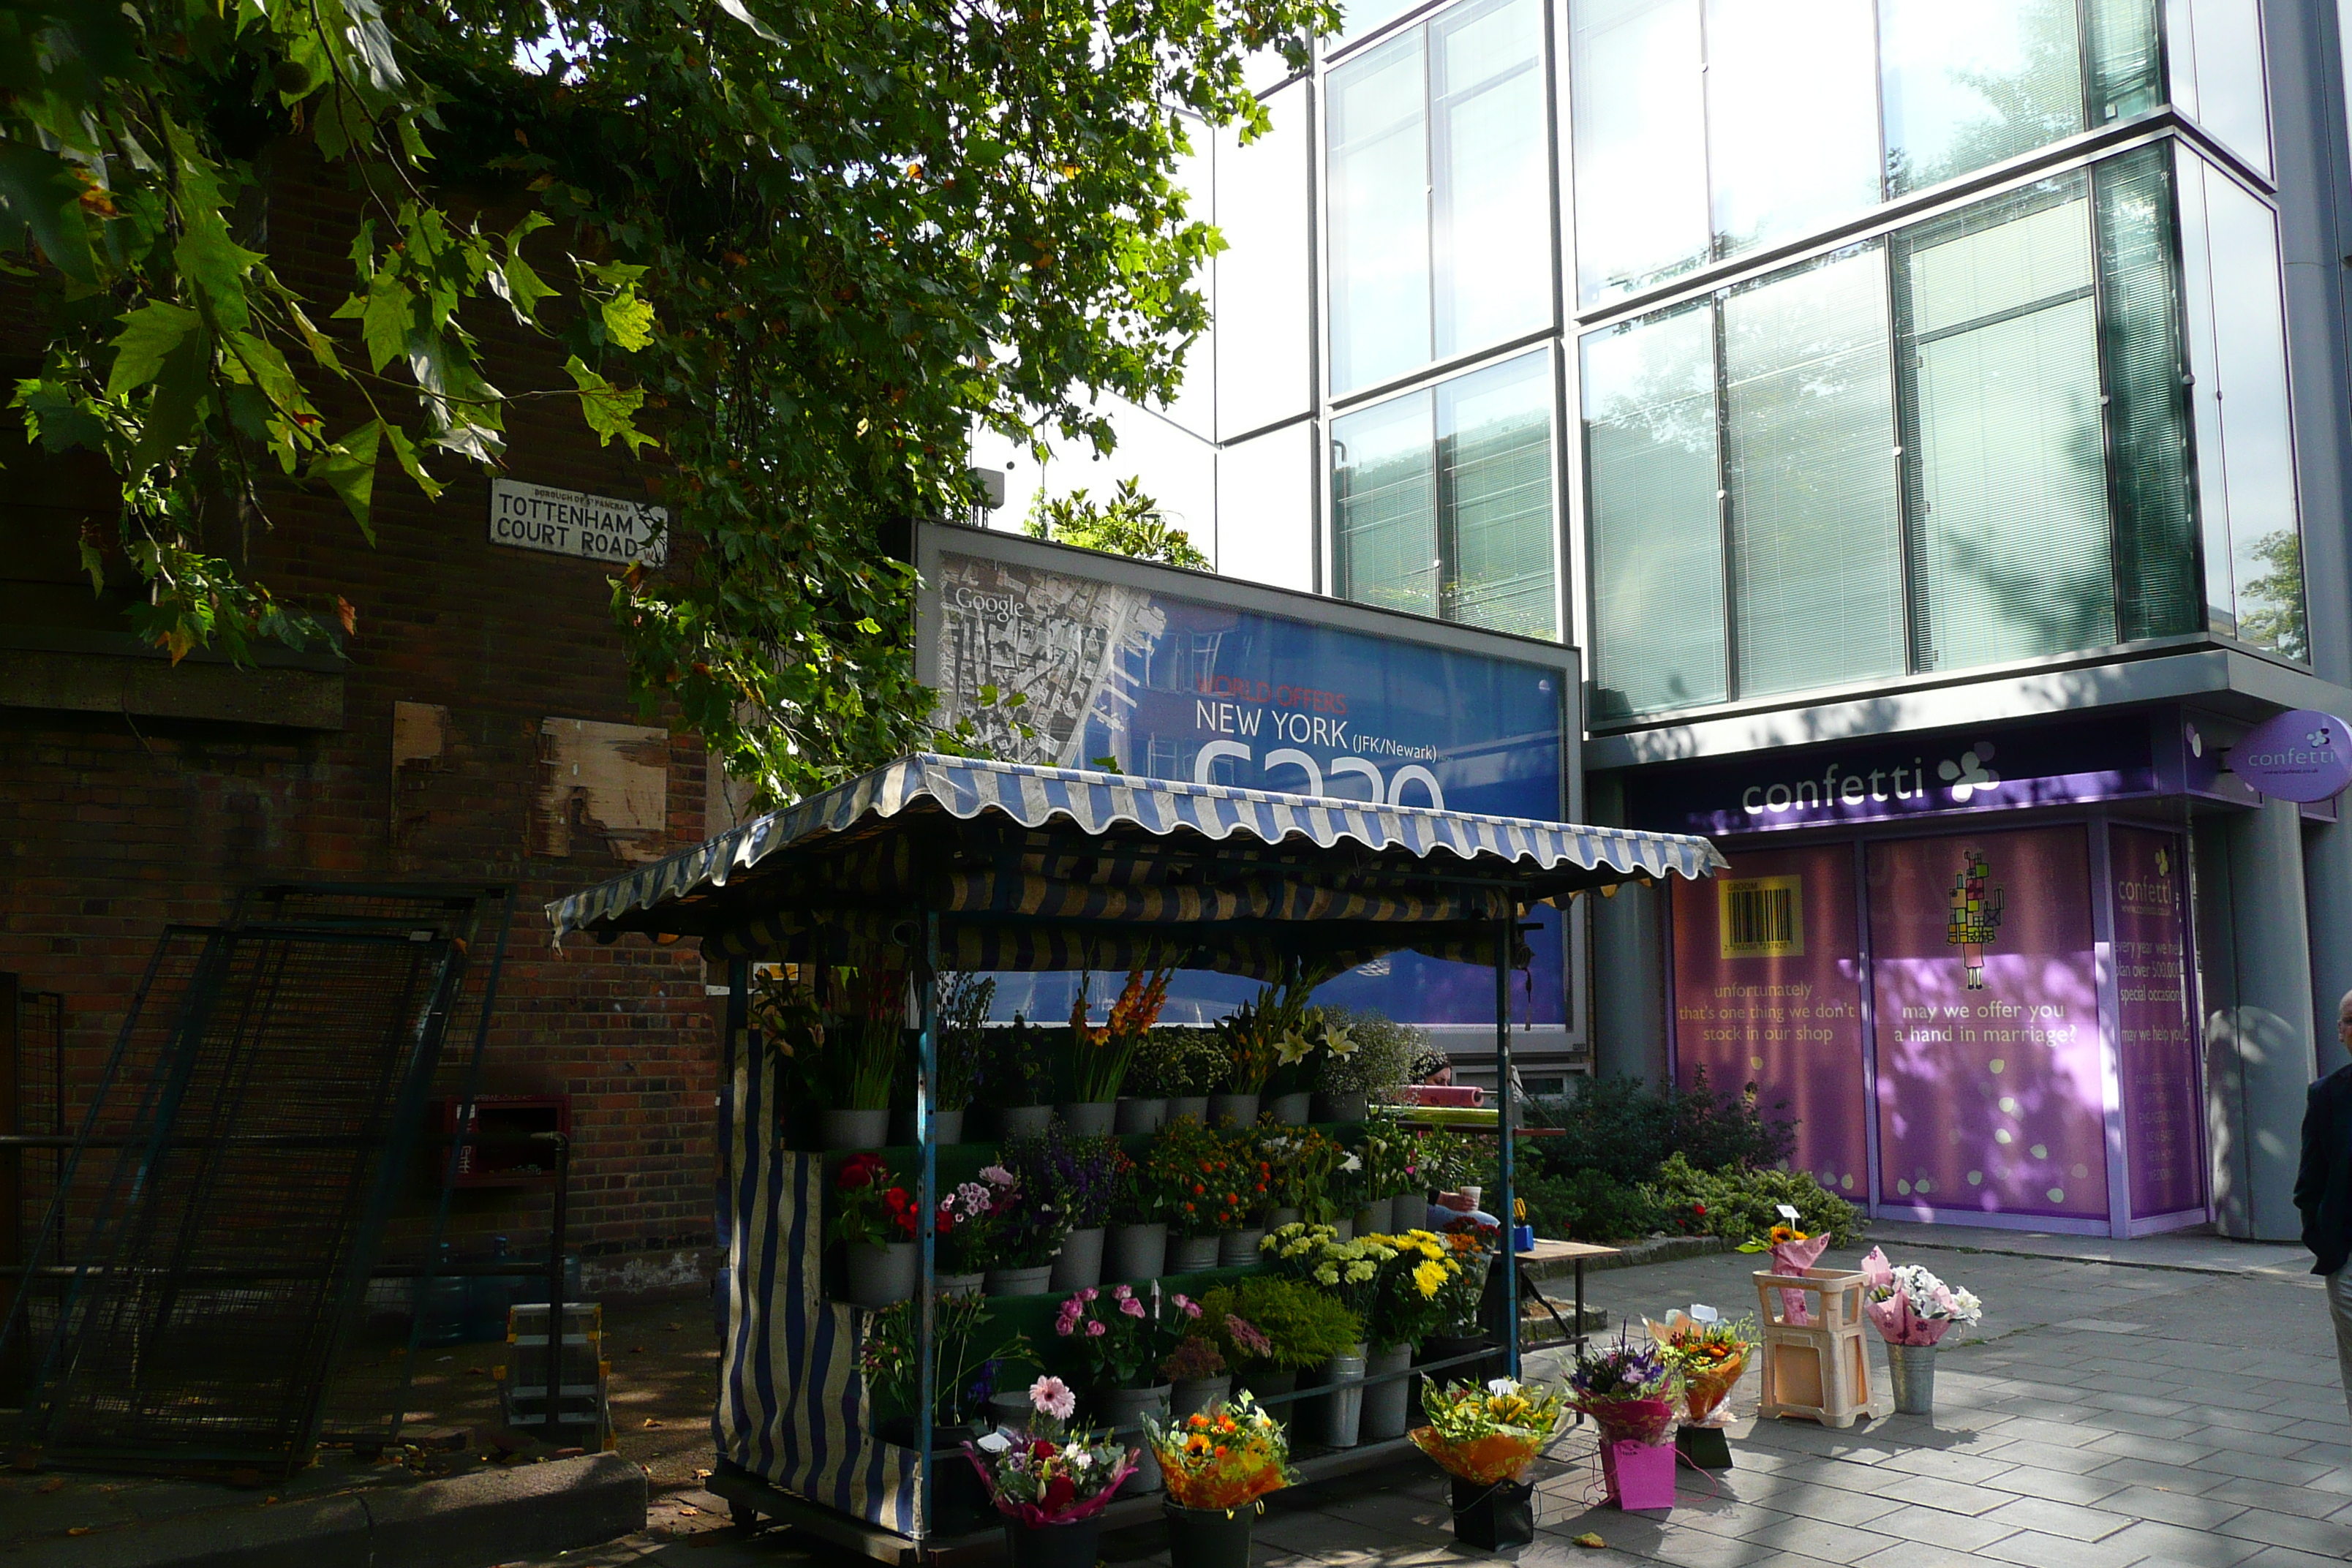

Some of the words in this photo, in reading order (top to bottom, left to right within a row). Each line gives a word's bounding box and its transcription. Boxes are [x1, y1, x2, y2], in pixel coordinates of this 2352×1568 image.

[534, 489, 573, 502] BOROUGH
[574, 495, 584, 504] OF
[595, 499, 630, 512] PANCRAS
[499, 493, 633, 535] TOTTENHAM
[497, 517, 570, 546] COURT
[581, 531, 638, 557] ROAD
[955, 587, 1024, 622] Google
[1195, 671, 1272, 703] WORLD
[1277, 684, 1347, 715] OFFERS
[1196, 699, 1262, 737] NEW
[1272, 710, 1349, 750] YORK
[1353, 734, 1437, 764] (JFK/Newark)
[2248, 747, 2335, 766] confetti
[1742, 757, 1924, 815] confetti
[1727, 882, 1758, 892] GROOM
[2118, 875, 2172, 905] confetti
[2136, 941, 2152, 959] year
[2155, 942, 2168, 955] we
[2133, 965, 2150, 977] over
[2121, 984, 2146, 1006] special
[1678, 1005, 1715, 1020] that's
[1719, 1007, 1746, 1019] one
[1750, 1004, 1784, 1023] thing
[1789, 1006, 1811, 1019] we
[1815, 1002, 1855, 1019] don't
[1901, 1005, 1937, 1023] may
[1943, 1006, 1970, 1018] we
[1977, 1000, 2022, 1018] offer
[2029, 1004, 2065, 1022] you
[1703, 1025, 1742, 1041] stock
[1746, 1025, 1759, 1041] in
[1764, 1028, 1790, 1041] our
[1795, 1024, 1834, 1046] shop
[1894, 1030, 1904, 1042] a
[1910, 1025, 1953, 1042] hand
[1959, 1025, 1976, 1042] in
[1983, 1024, 2078, 1047] marriage?
[2122, 1028, 2138, 1047] may
[2138, 1028, 2152, 1041] we
[2152, 1024, 2169, 1045] help
